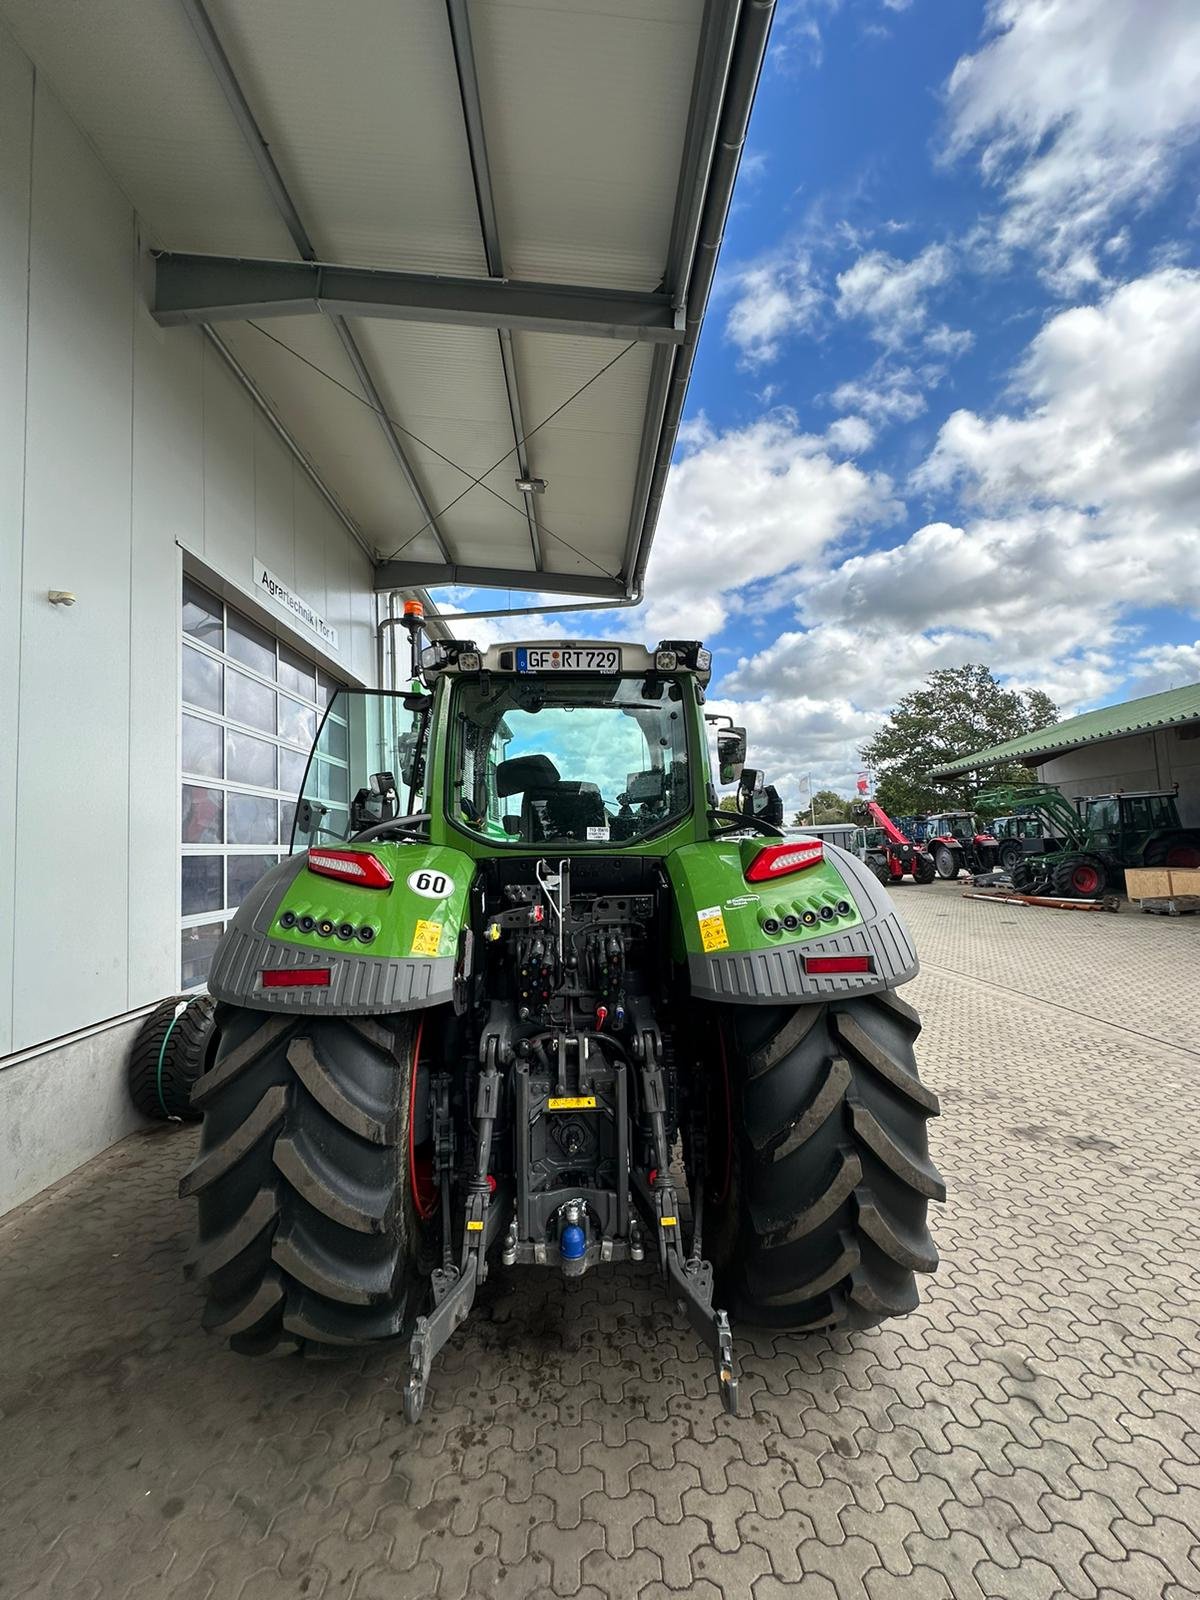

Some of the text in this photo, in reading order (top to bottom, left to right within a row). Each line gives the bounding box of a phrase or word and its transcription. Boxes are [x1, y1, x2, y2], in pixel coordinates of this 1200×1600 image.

[262, 570, 314, 625] Agrartechnik
[319, 619, 330, 638] Tor
[529, 651, 616, 668] GF RT 729
[416, 873, 446, 894] 60
